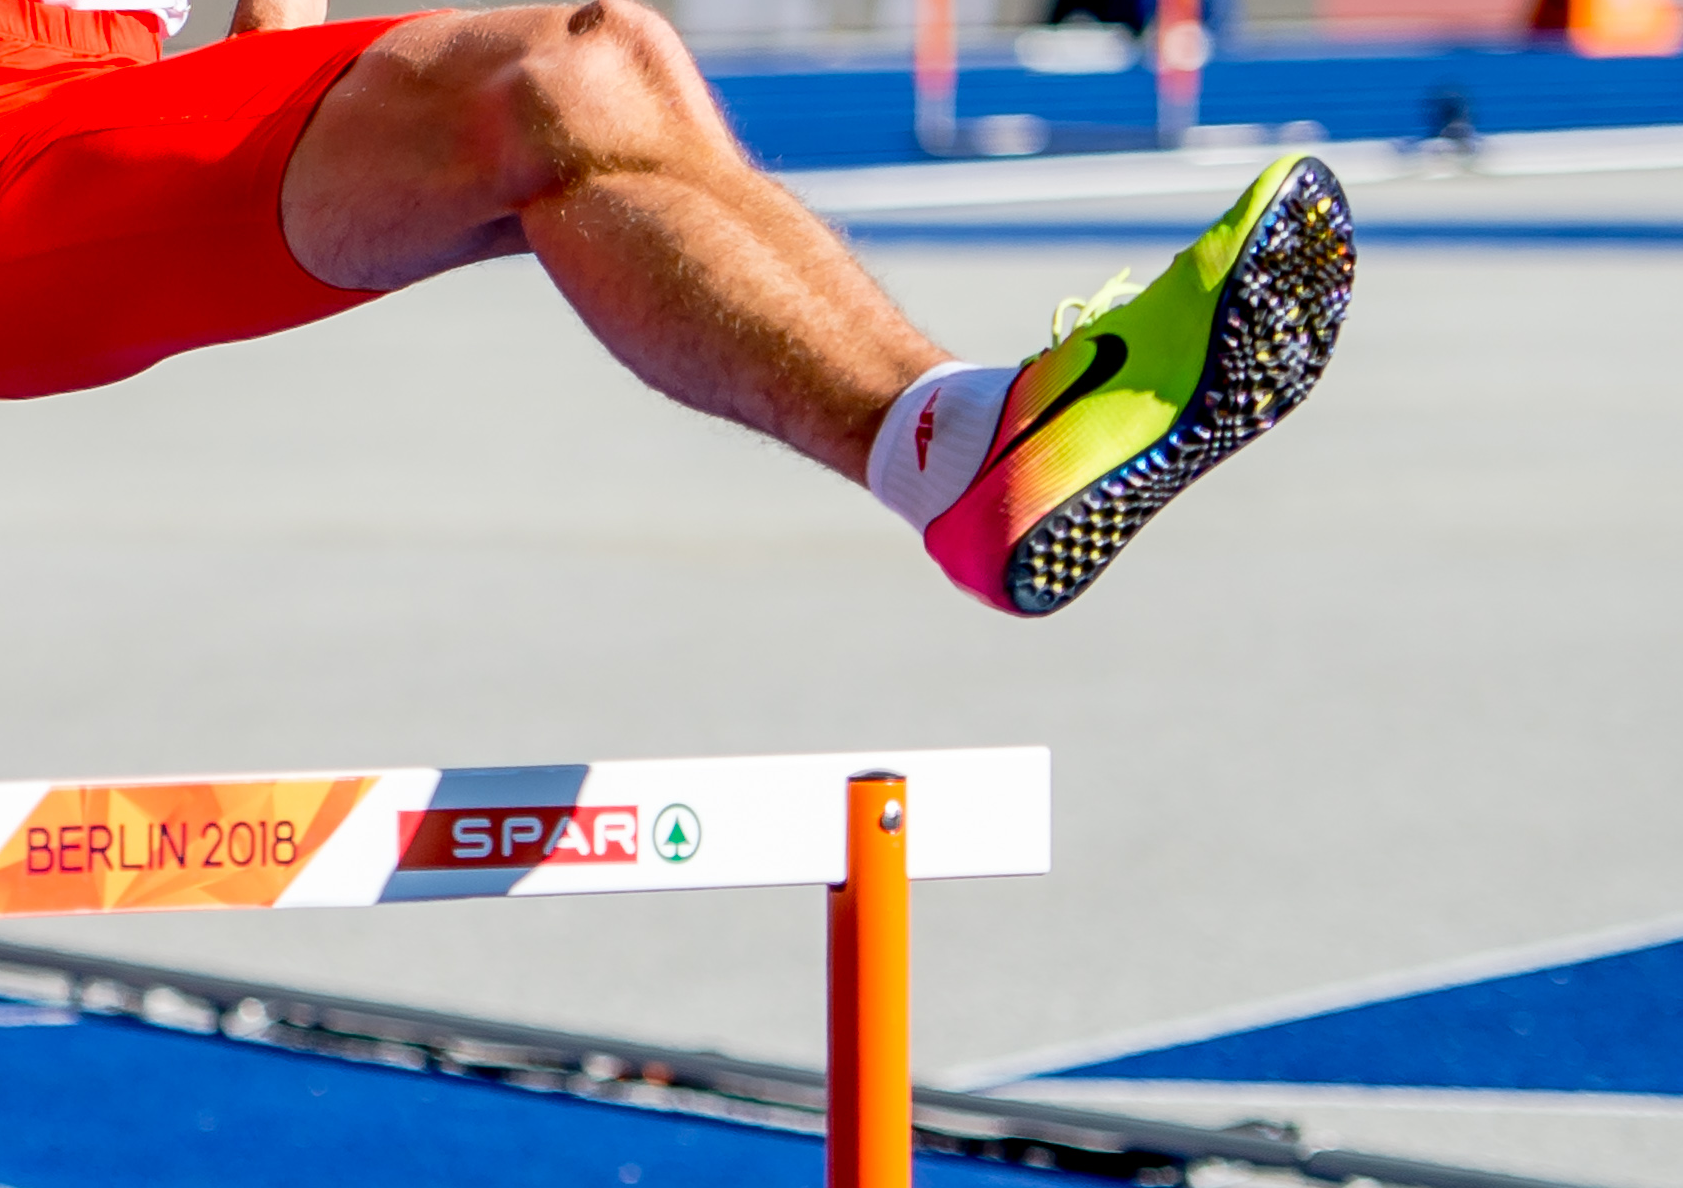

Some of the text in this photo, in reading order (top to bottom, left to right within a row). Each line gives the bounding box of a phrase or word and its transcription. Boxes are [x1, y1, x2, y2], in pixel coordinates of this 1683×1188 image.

[27, 821, 186, 874] BERLIN
[200, 820, 297, 868] 2018
[452, 813, 637, 859] SPAR
